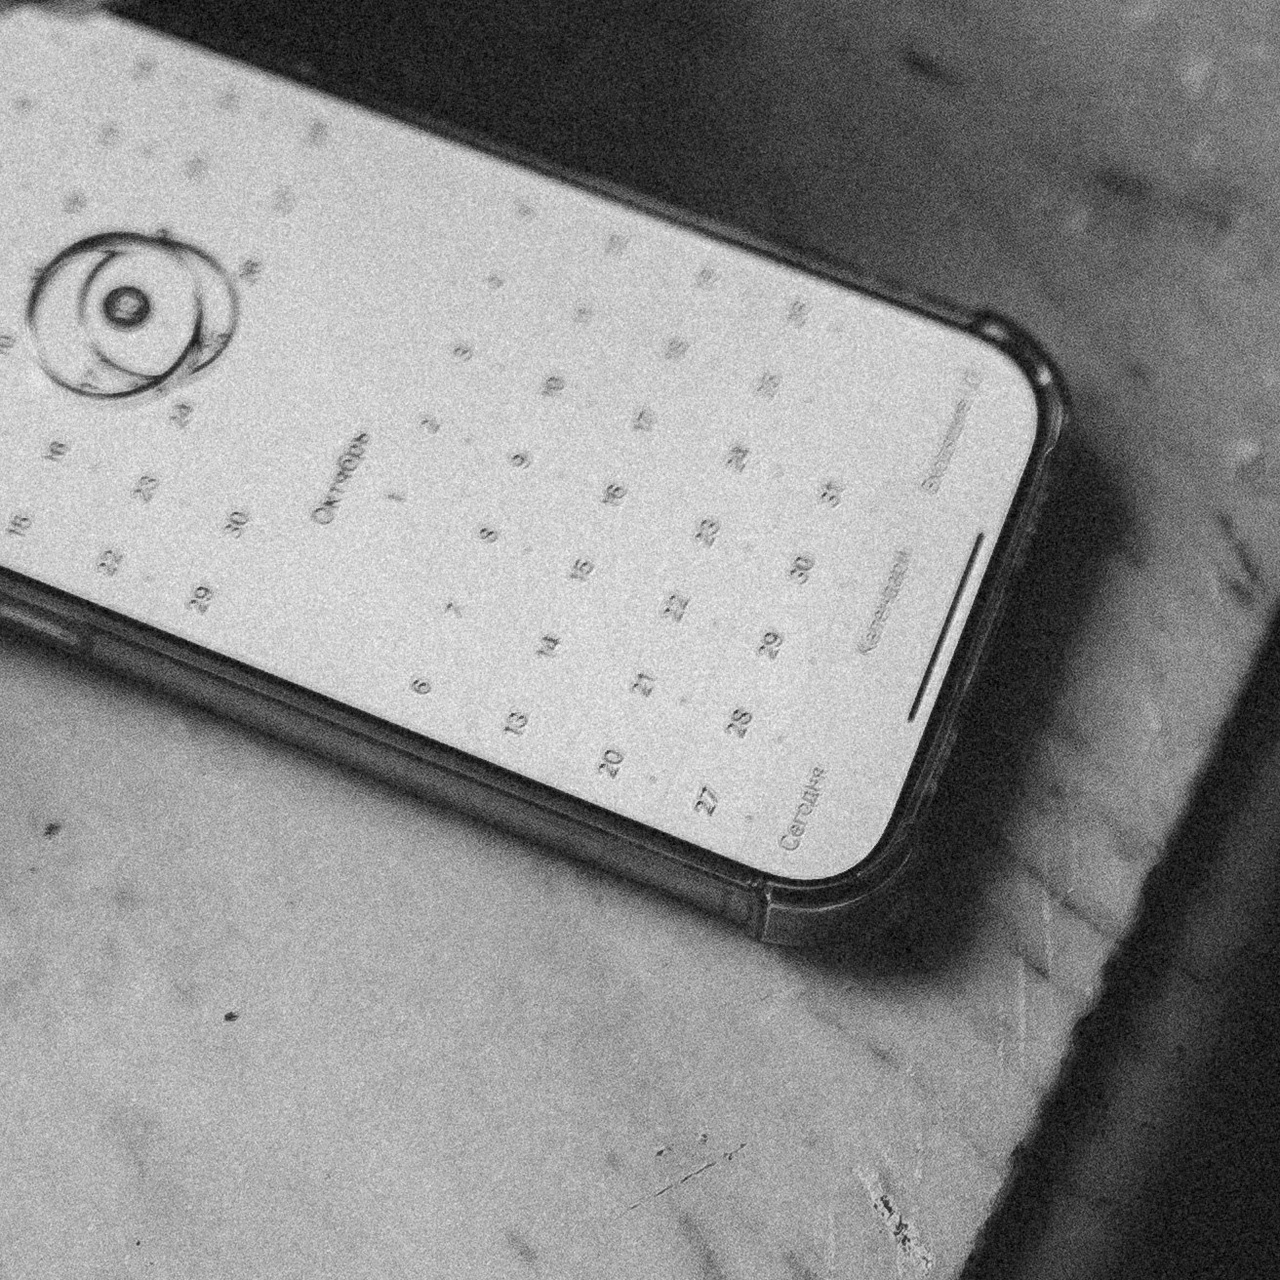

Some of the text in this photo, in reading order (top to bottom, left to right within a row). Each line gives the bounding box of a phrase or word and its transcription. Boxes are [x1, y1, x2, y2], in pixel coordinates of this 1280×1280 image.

[186, 510, 250, 614] 29 30
[309, 433, 370, 525] Октябрь
[410, 678, 432, 695] 6
[478, 526, 499, 543] 8
[503, 711, 528, 735] 13
[536, 635, 560, 656] 14
[568, 558, 594, 581] 15
[601, 482, 627, 505] 16
[597, 748, 624, 779] 20
[630, 672, 655, 697] 21
[660, 592, 690, 623] 22
[694, 518, 720, 547] 23
[694, 480, 843, 816] 27 28 29 30 31
[779, 766, 826, 852] Сегодня
